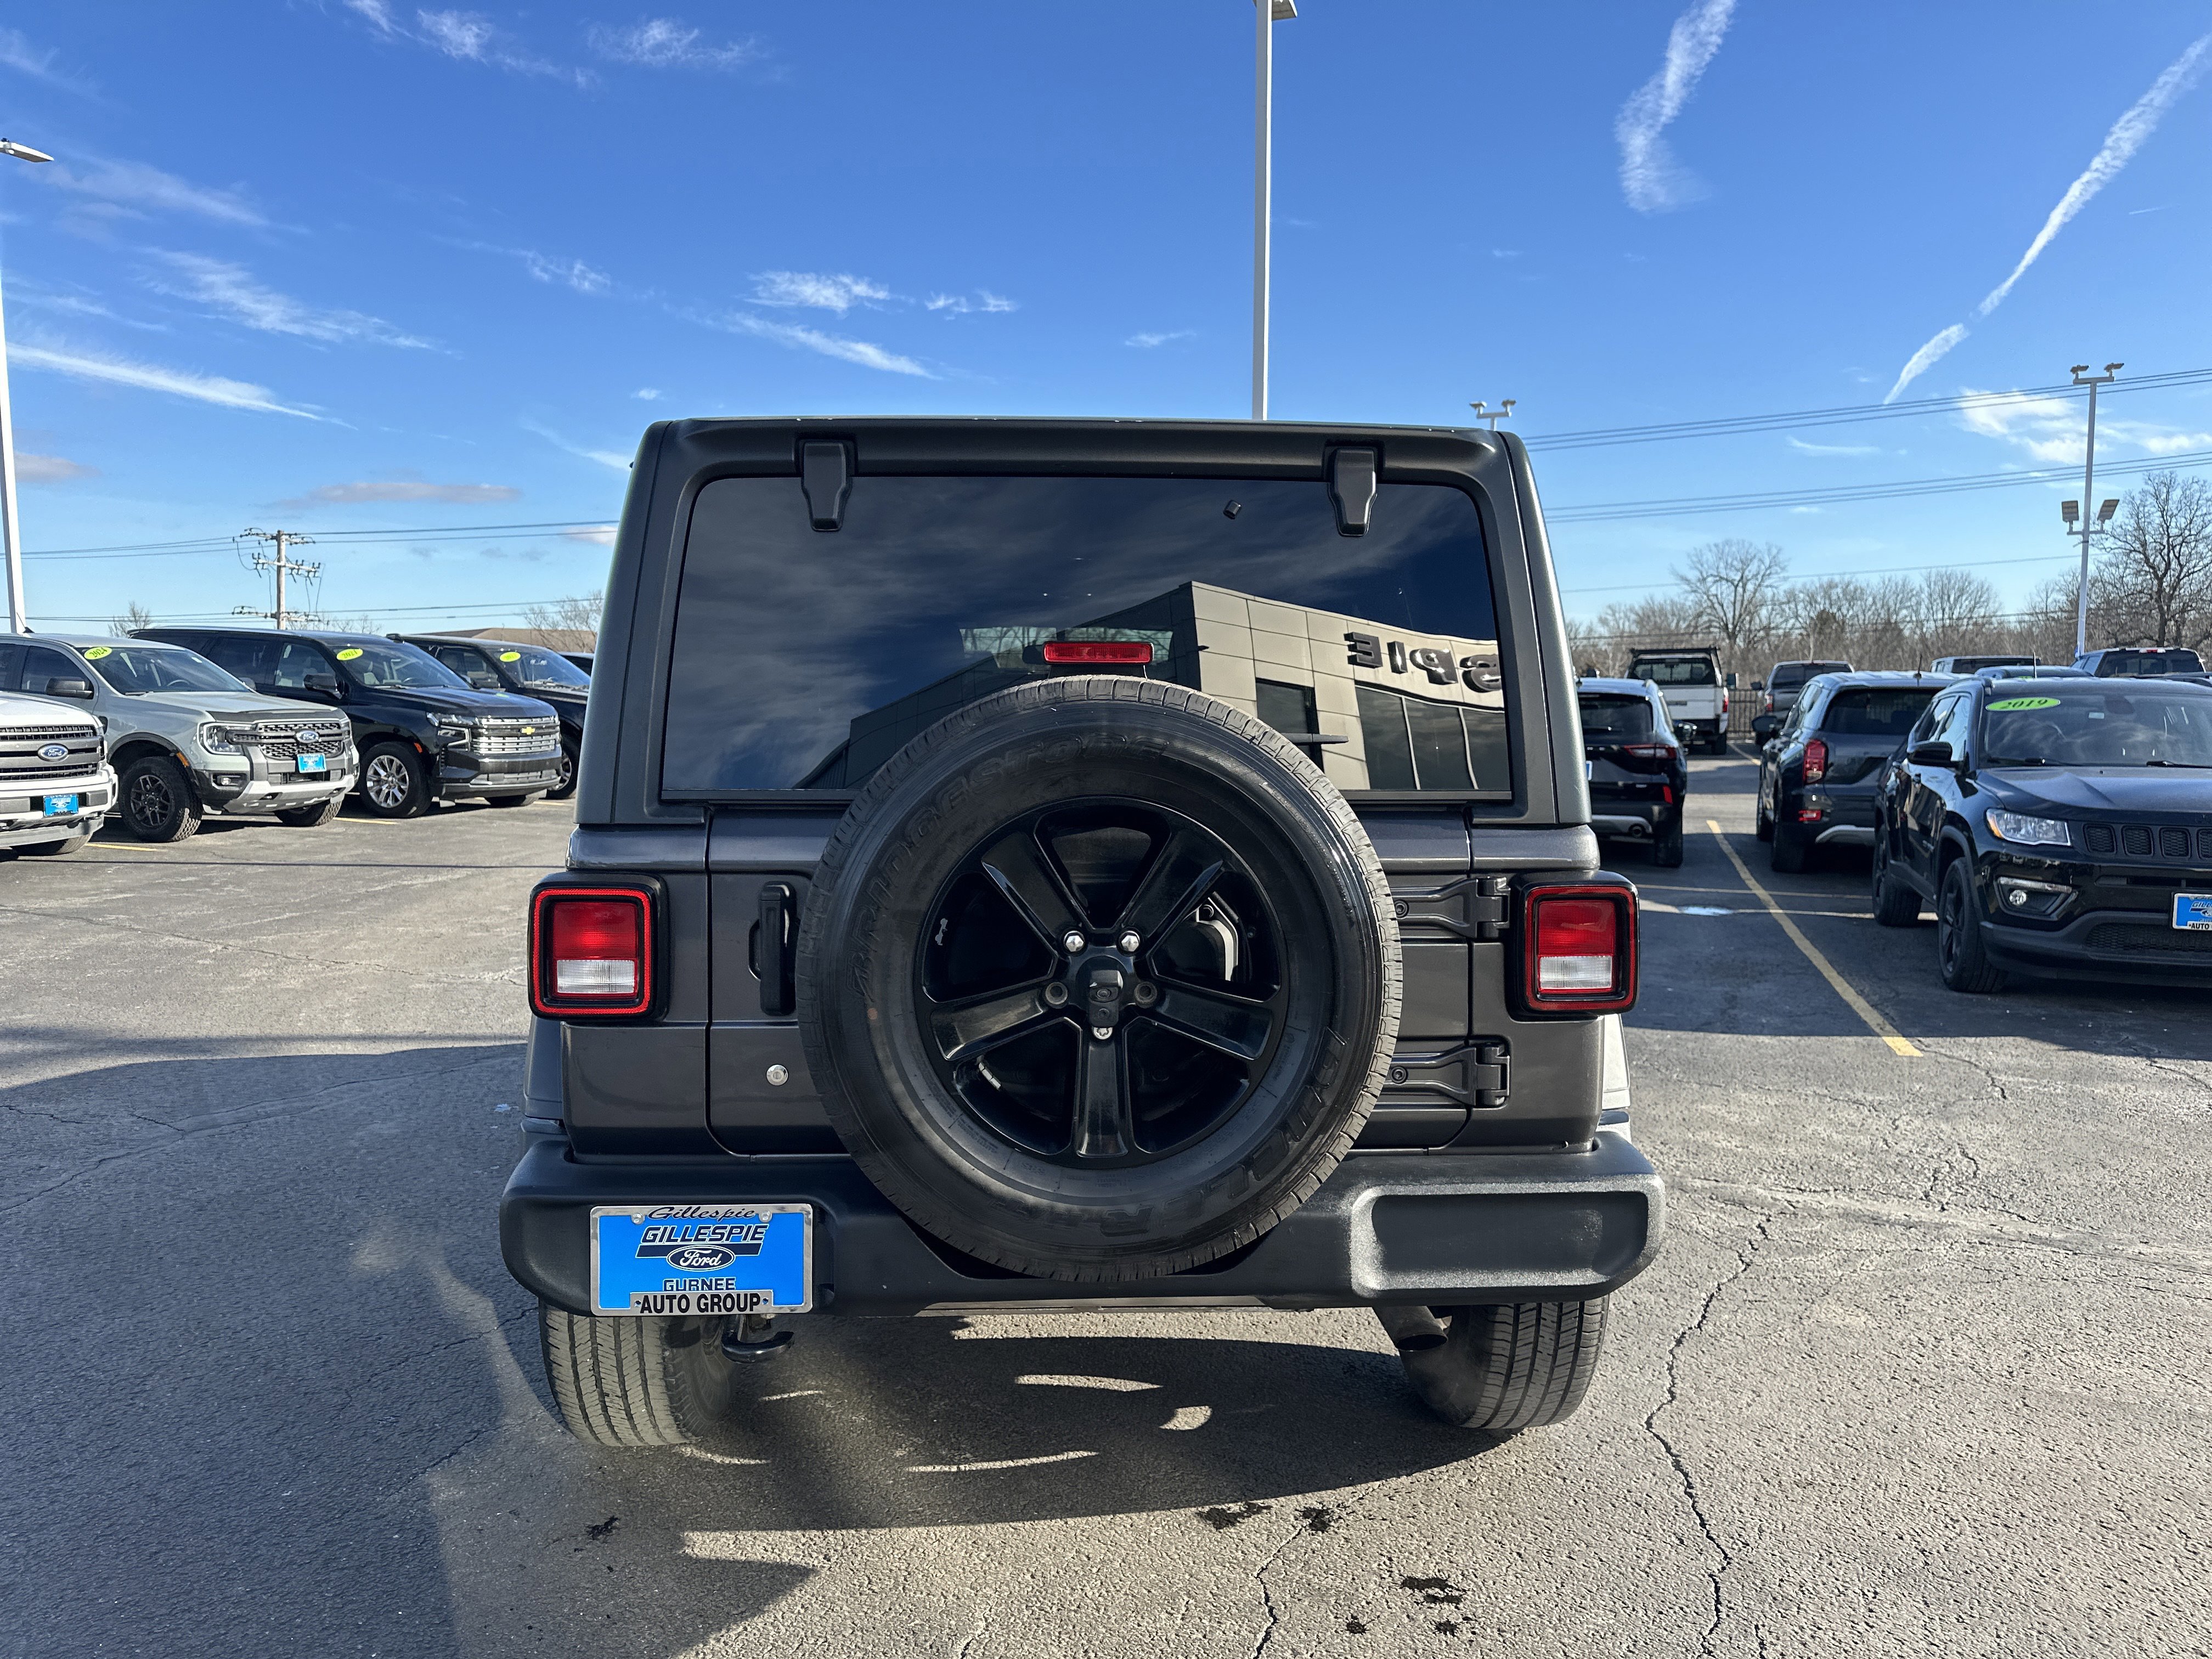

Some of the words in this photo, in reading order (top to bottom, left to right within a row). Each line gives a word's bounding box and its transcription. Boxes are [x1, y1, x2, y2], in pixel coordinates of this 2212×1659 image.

[2000, 699, 2048, 710] 2019
[648, 1206, 755, 1222] Gillespie
[641, 1224, 769, 1244] GILLESPIE
[679, 1249, 722, 1267] Ford
[663, 1277, 736, 1291] GURNEE
[640, 1295, 691, 1314] AUTO
[696, 1293, 761, 1313] GROUP
